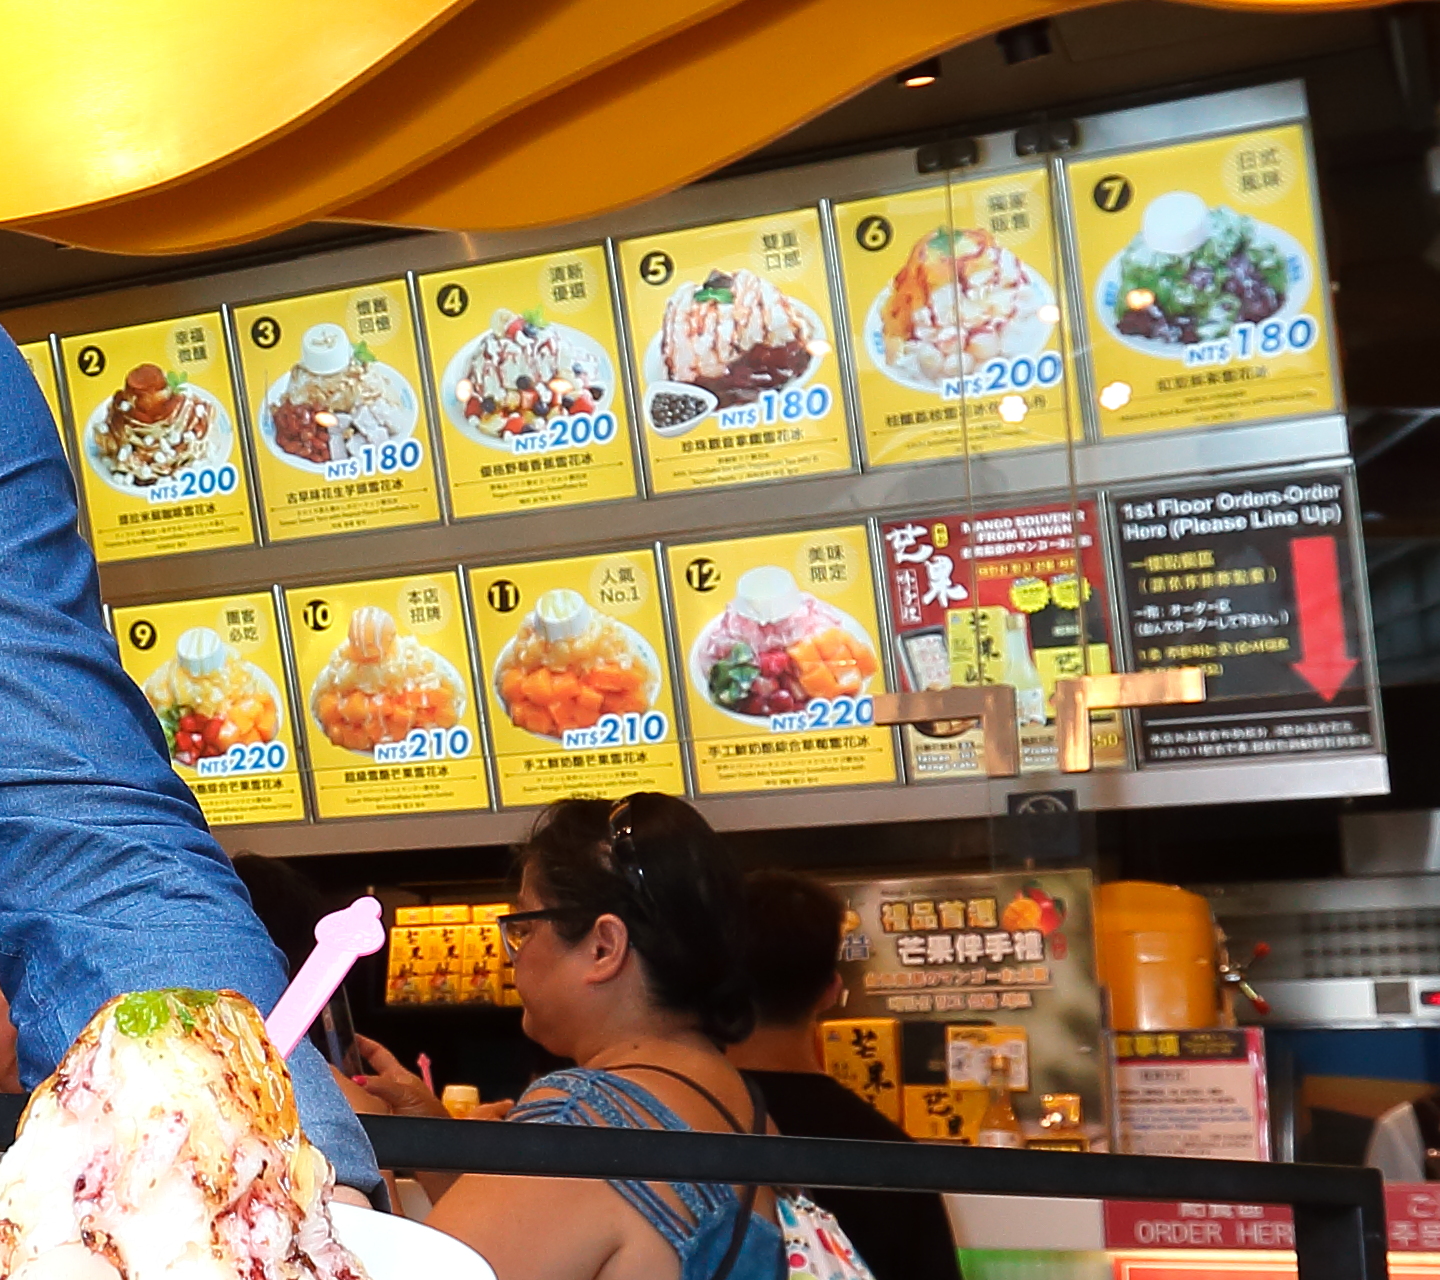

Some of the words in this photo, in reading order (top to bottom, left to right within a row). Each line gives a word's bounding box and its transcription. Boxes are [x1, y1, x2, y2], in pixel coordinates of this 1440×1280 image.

[1188, 320, 1312, 363] NT$180
[945, 354, 1063, 397] NT$200
[721, 387, 829, 427] NT$180
[515, 413, 615, 452] NT$200
[327, 440, 421, 479] NT$180
[149, 466, 237, 502] NT$200
[1122, 503, 1155, 520] 1st
[1157, 497, 1215, 517] Floor
[1217, 483, 1342, 511] Orders-Order
[977, 526, 1019, 543] FROM
[1021, 523, 1073, 541] TAIWAN
[1014, 510, 1086, 529] SOUVENR
[1123, 522, 1168, 541] Here
[1170, 516, 1248, 540] (Please
[1250, 509, 1299, 530] Line
[1301, 503, 1342, 525] Up)
[689, 563, 719, 590] 12
[491, 584, 517, 608] 11
[600, 586, 640, 604] No.1
[306, 604, 333, 628] 10
[566, 714, 665, 747] NT$210
[771, 697, 874, 732] NT$220
[201, 743, 285, 775] NT$220
[377, 729, 468, 761] NT$210
[896, 929, 1045, 968] 芒果伴手禮
[1135, 1221, 1224, 1246] ORDER
